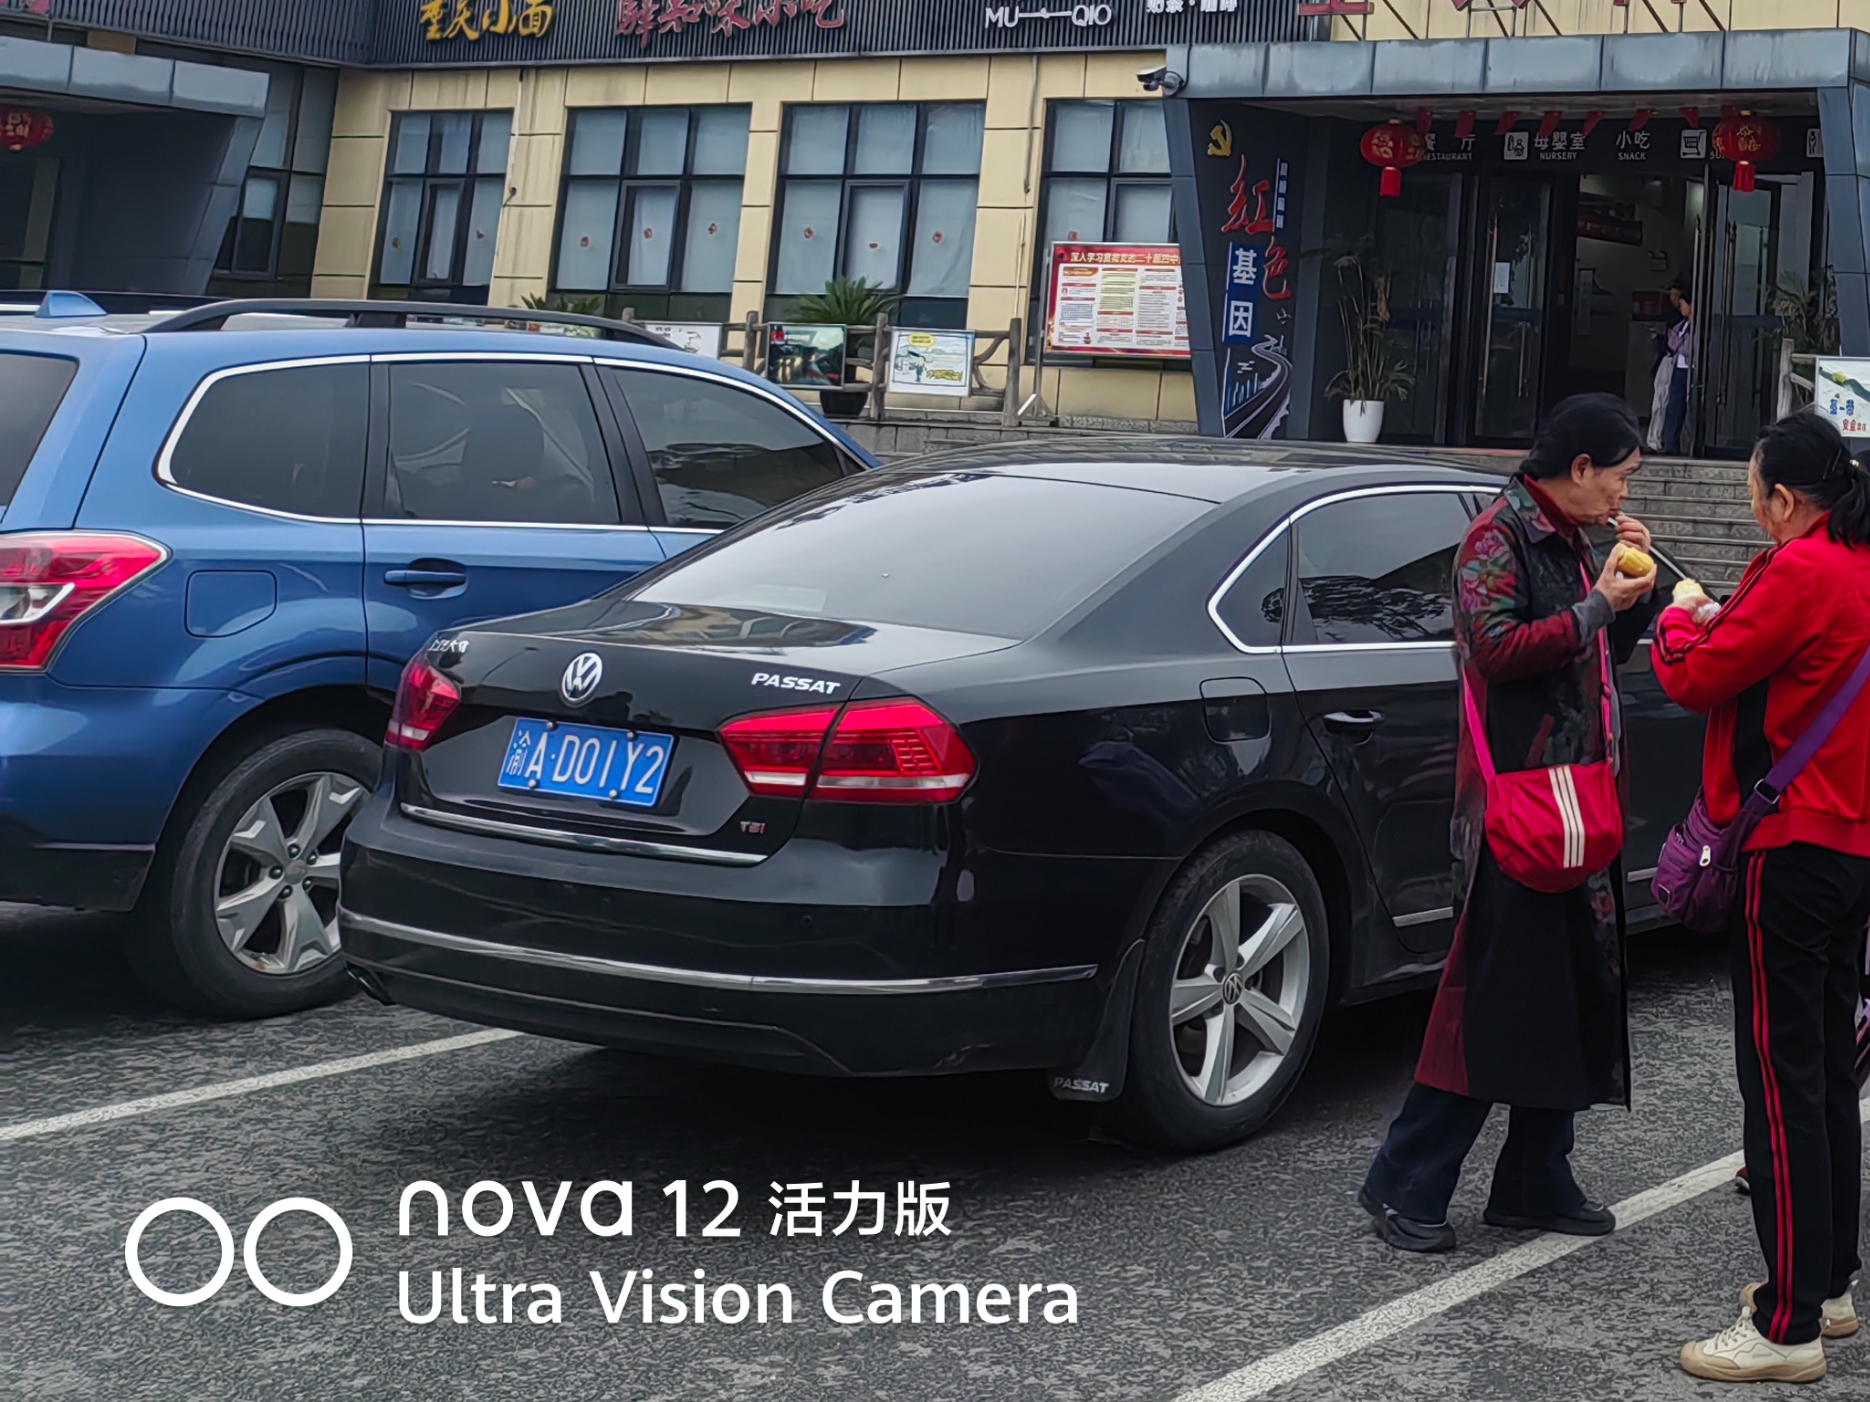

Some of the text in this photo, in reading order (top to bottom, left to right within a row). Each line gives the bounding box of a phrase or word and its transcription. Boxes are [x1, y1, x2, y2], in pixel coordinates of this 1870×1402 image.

[1533, 131, 1586, 150] 母婴室
[1615, 130, 1651, 149] 小吃
[1539, 152, 1578, 161] NURSERY
[1618, 151, 1646, 161] SNACK
[1070, 252, 1180, 264] 深入学习贯彻党的二十届四中
[1227, 247, 1258, 338] 基因
[751, 672, 841, 695] PASSAT
[1053, 1076, 1110, 1094] PASSAT
